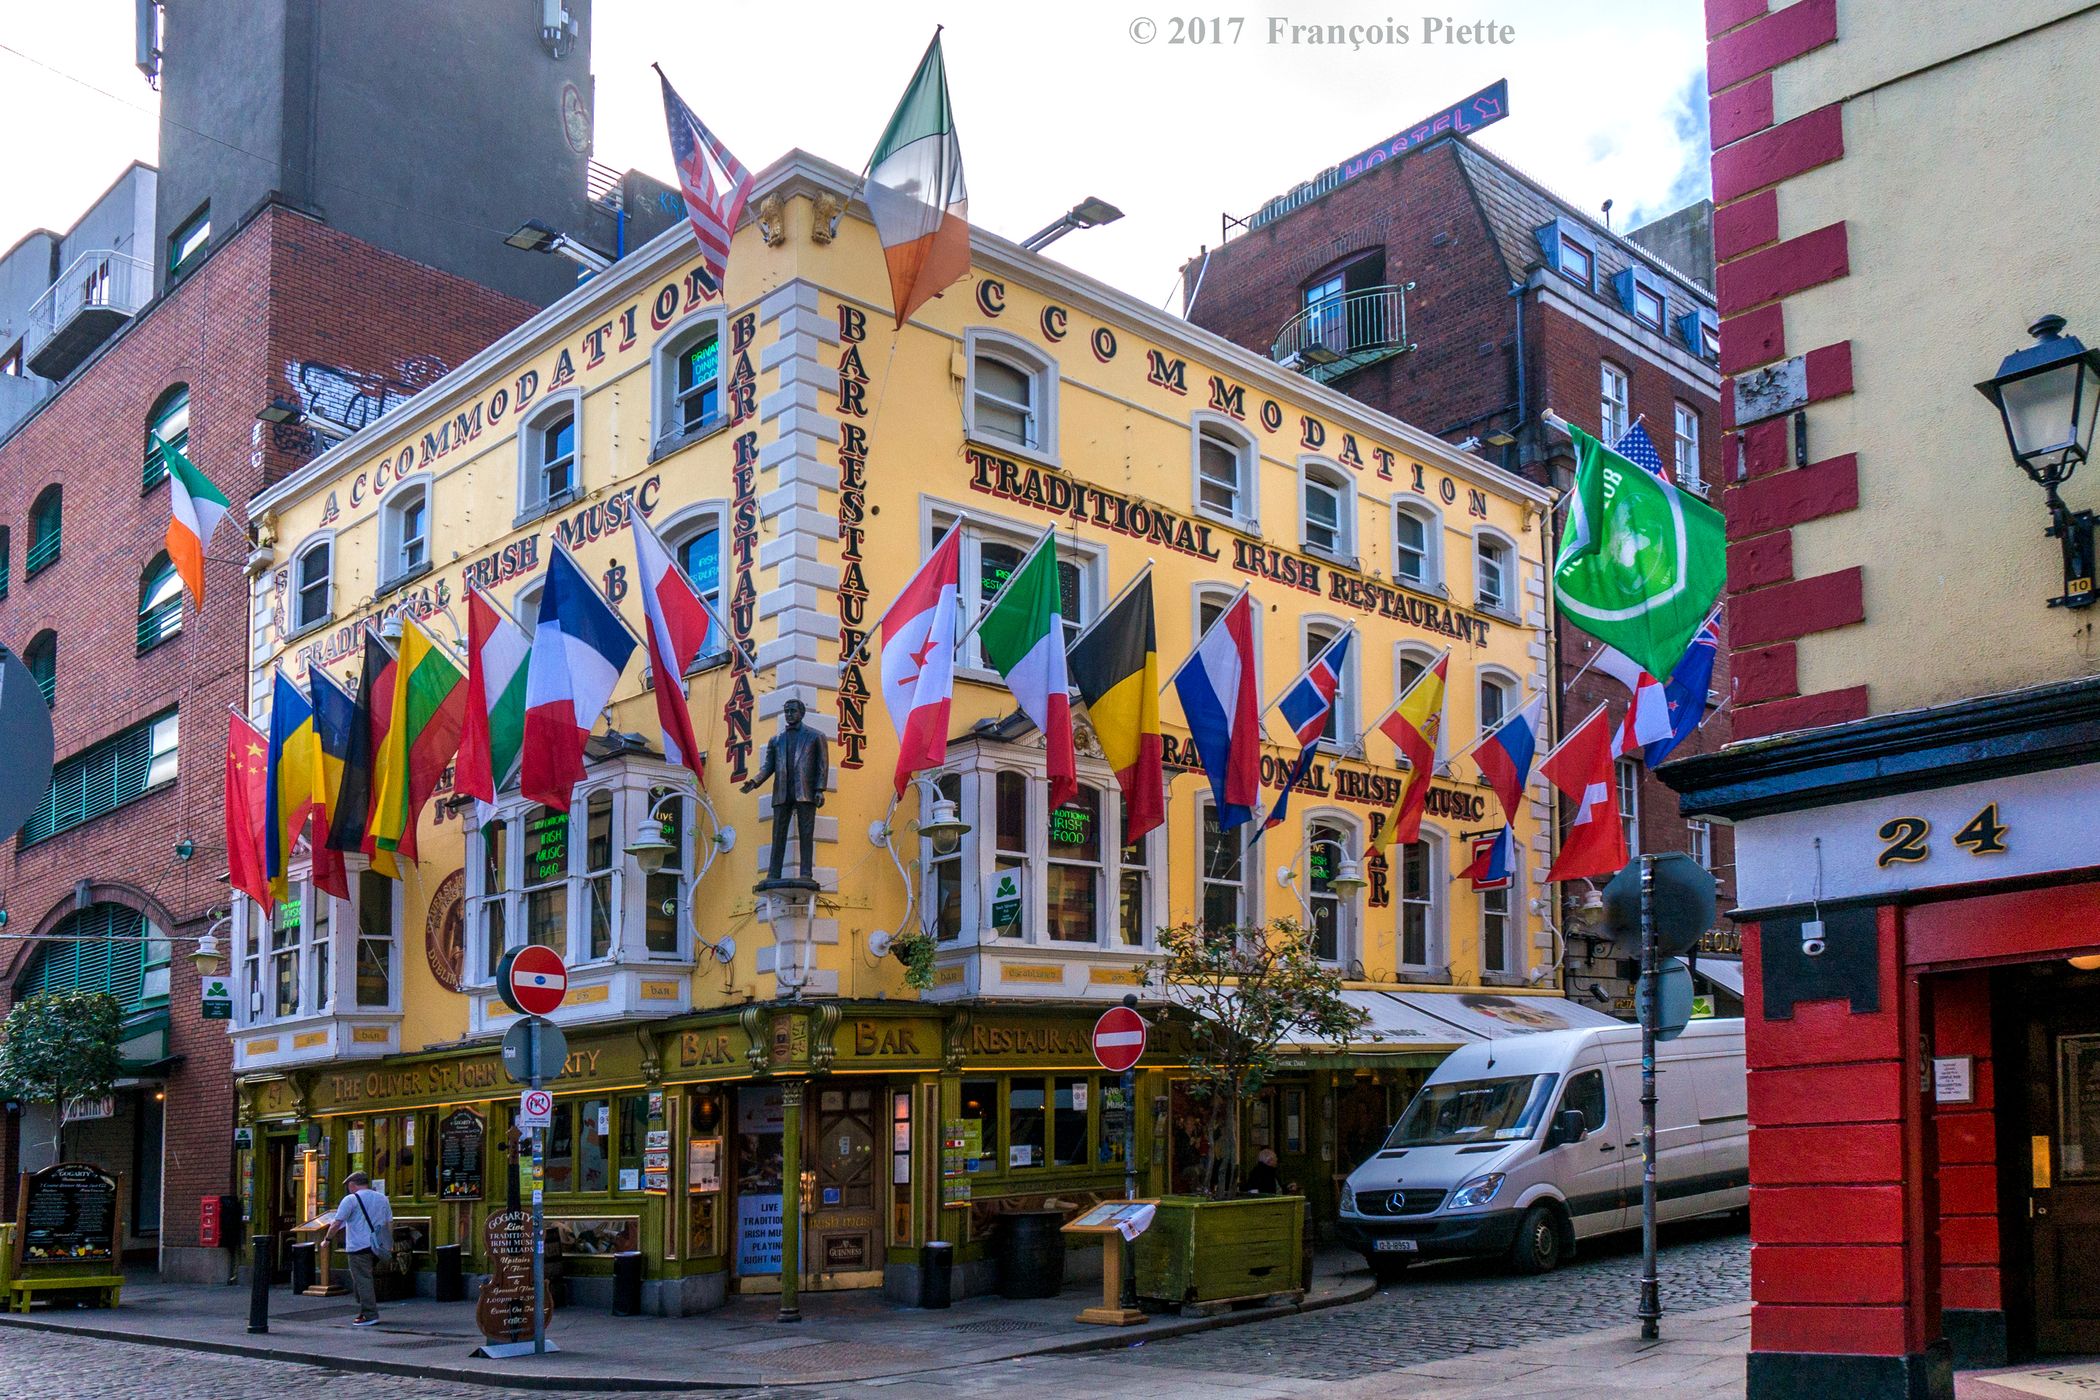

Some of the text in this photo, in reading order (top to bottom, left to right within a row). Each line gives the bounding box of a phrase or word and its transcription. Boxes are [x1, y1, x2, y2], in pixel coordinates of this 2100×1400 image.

[1344, 108, 1472, 180] HOSTEL
[691, 341, 720, 366] PRIVAT
[320, 265, 721, 527] ACCOMMODATION
[976, 278, 1489, 521] CCOMMODATION
[461, 533, 541, 603] IRISH
[556, 474, 661, 552] MUSIC
[724, 310, 760, 783] BAR RESTAURANT
[837, 303, 871, 771] BAR RESTAURANT
[965, 447, 1491, 649] TRADITIONAL IRISH RESTAURANT
[1334, 768, 1402, 809] IRISH
[1423, 788, 1486, 823] MUSIC
[655, 811, 674, 822] LIVE
[1054, 817, 1083, 831] IRISH
[1053, 829, 1085, 844] FOOD
[1876, 800, 2010, 870] 24
[539, 862, 559, 879] BAR
[1368, 811, 1390, 909] BAR
[680, 1031, 735, 1068] BAR
[854, 1021, 921, 1057] BAR
[971, 1023, 1092, 1056] RESTAURAN
[332, 1075, 361, 1103] THE
[365, 1072, 423, 1098] OLIVER
[455, 1061, 498, 1092] JOHN
[761, 1202, 778, 1212] LIVE
[504, 1222, 525, 1232] Live
[744, 1215, 782, 1226] TRADITIO
[489, 1232, 534, 1240] TRADITIONA
[490, 1239, 534, 1248] IRISH MUSI
[744, 1229, 766, 1239] IRISH
[752, 1240, 782, 1252] PLAYIN
[492, 1246, 534, 1255] & BALLADS
[743, 1254, 782, 1265] RIGHT NO
[829, 1248, 863, 1257] GUINNESS
